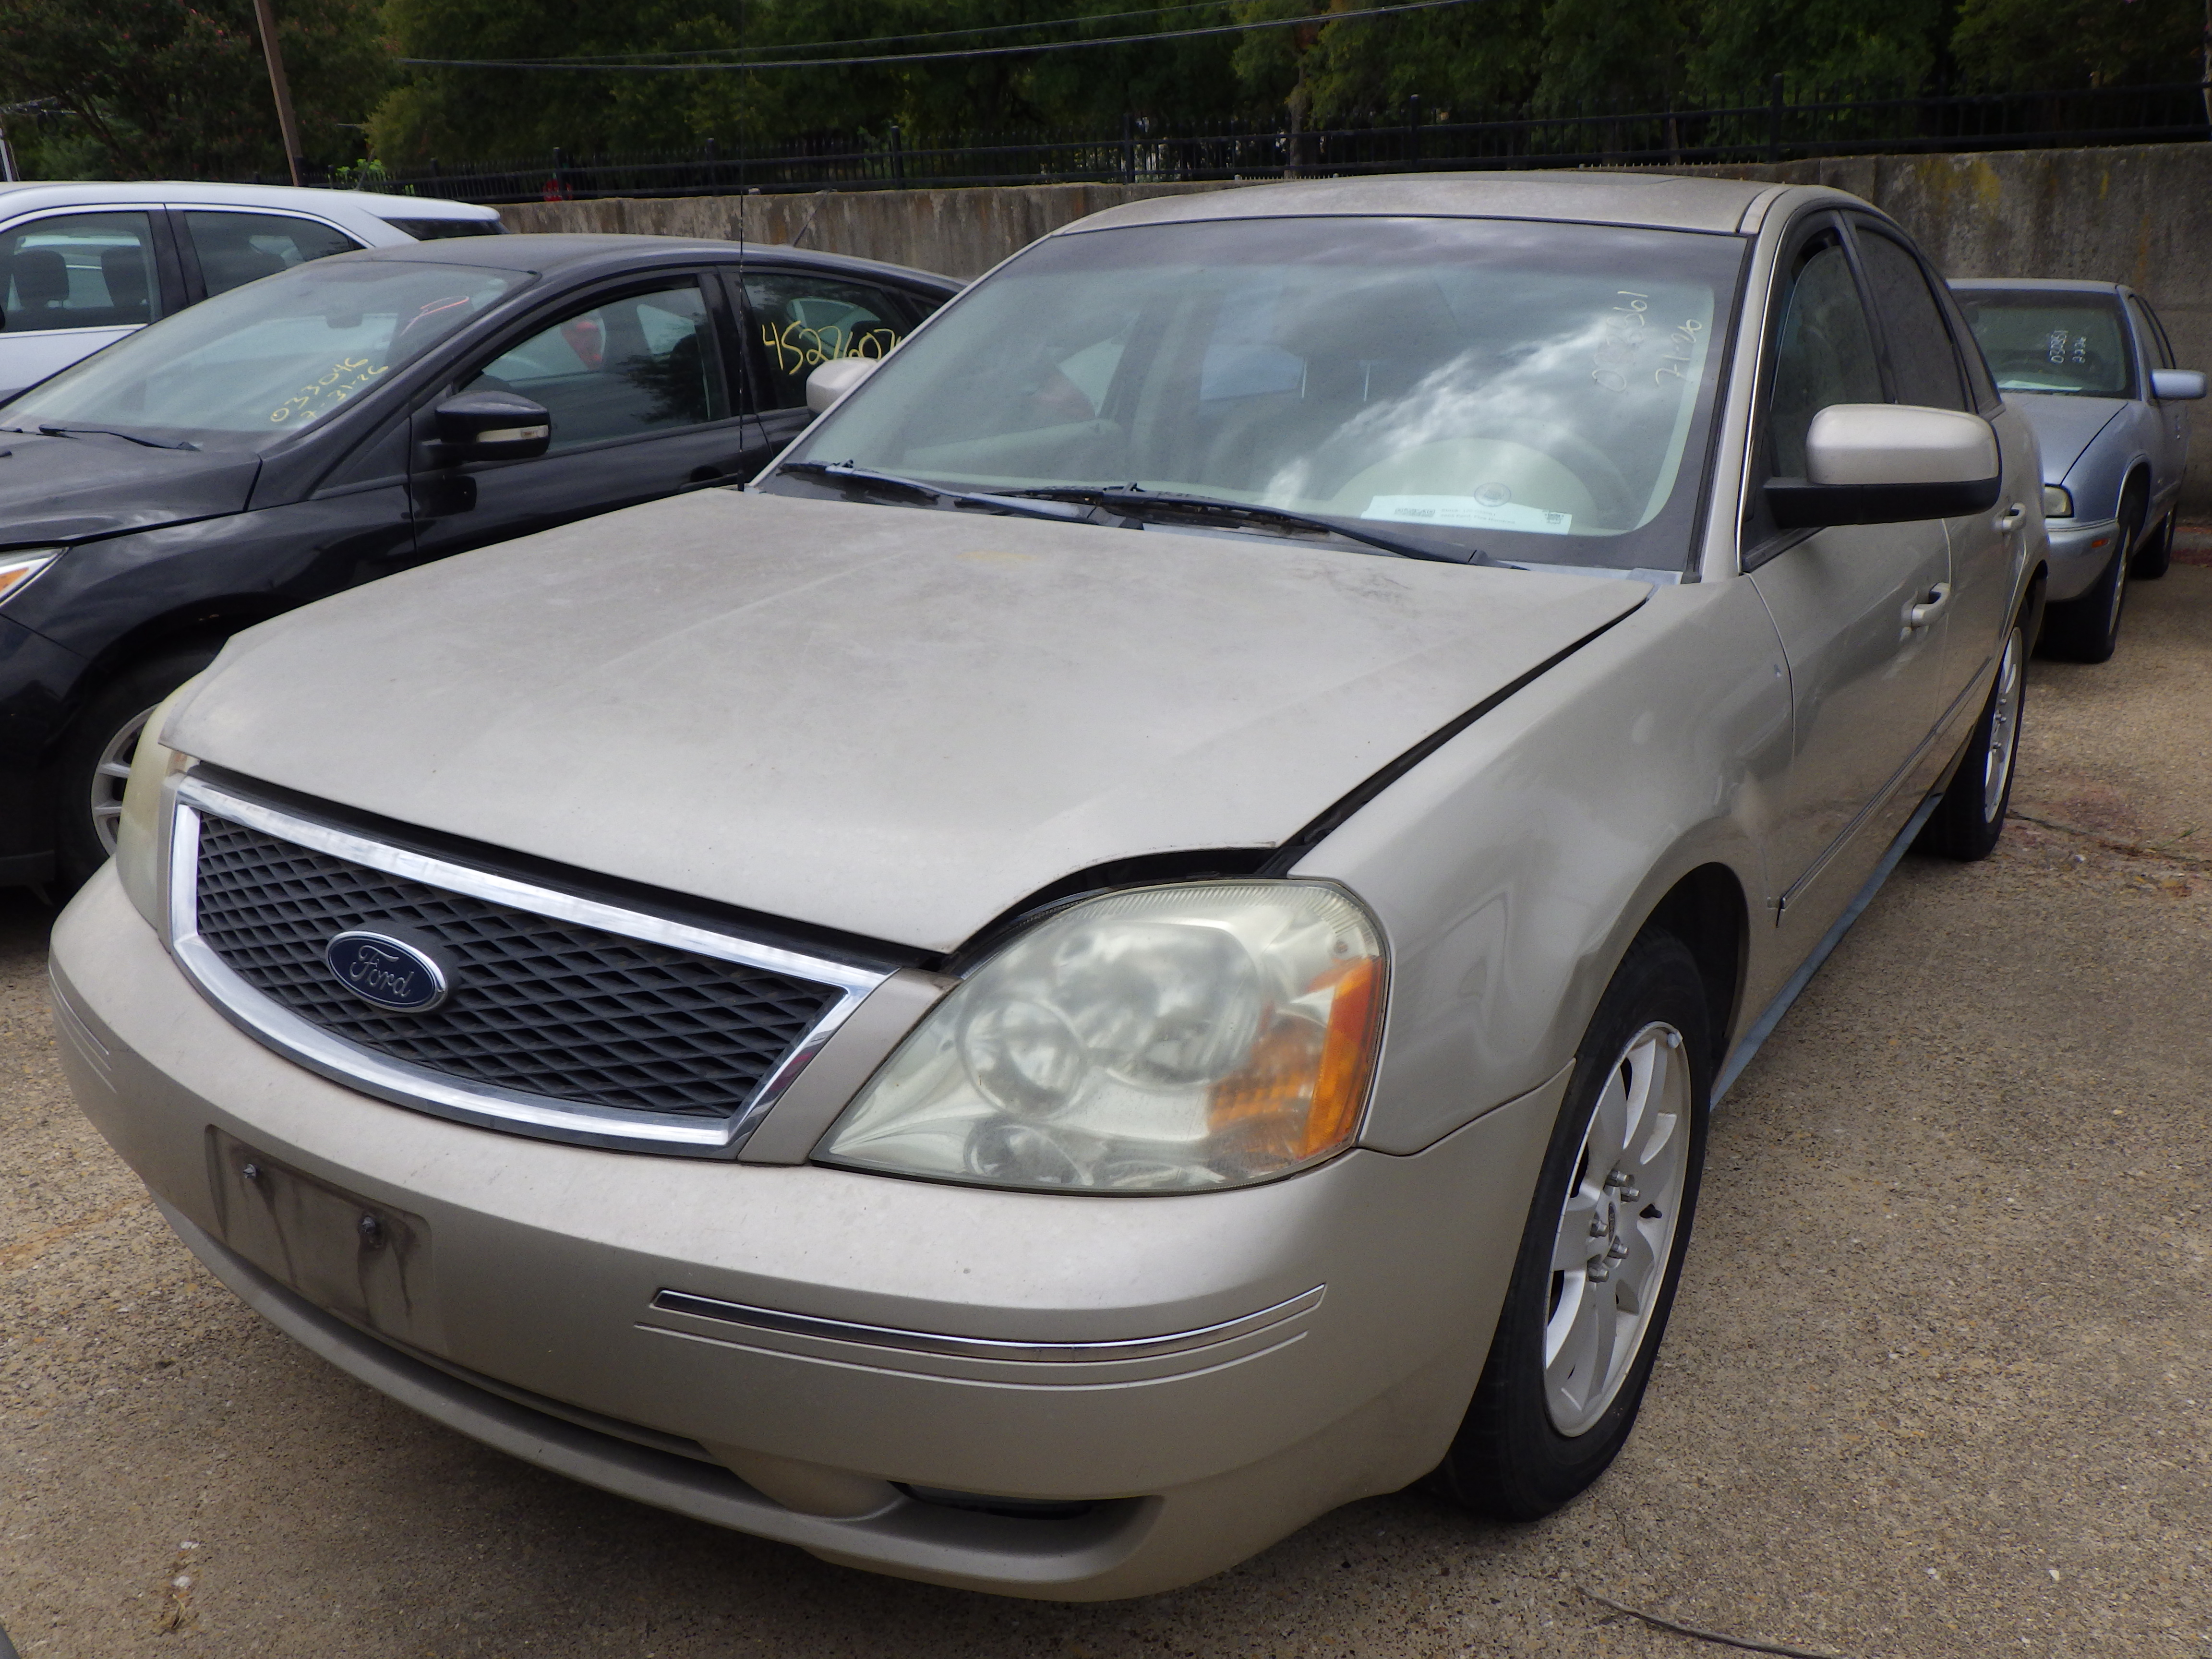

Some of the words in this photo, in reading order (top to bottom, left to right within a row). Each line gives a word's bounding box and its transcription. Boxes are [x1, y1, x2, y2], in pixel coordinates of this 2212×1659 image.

[762, 320, 902, 375] 4527607
[270, 358, 369, 422] 033046
[349, 944, 414, 998] Ford
